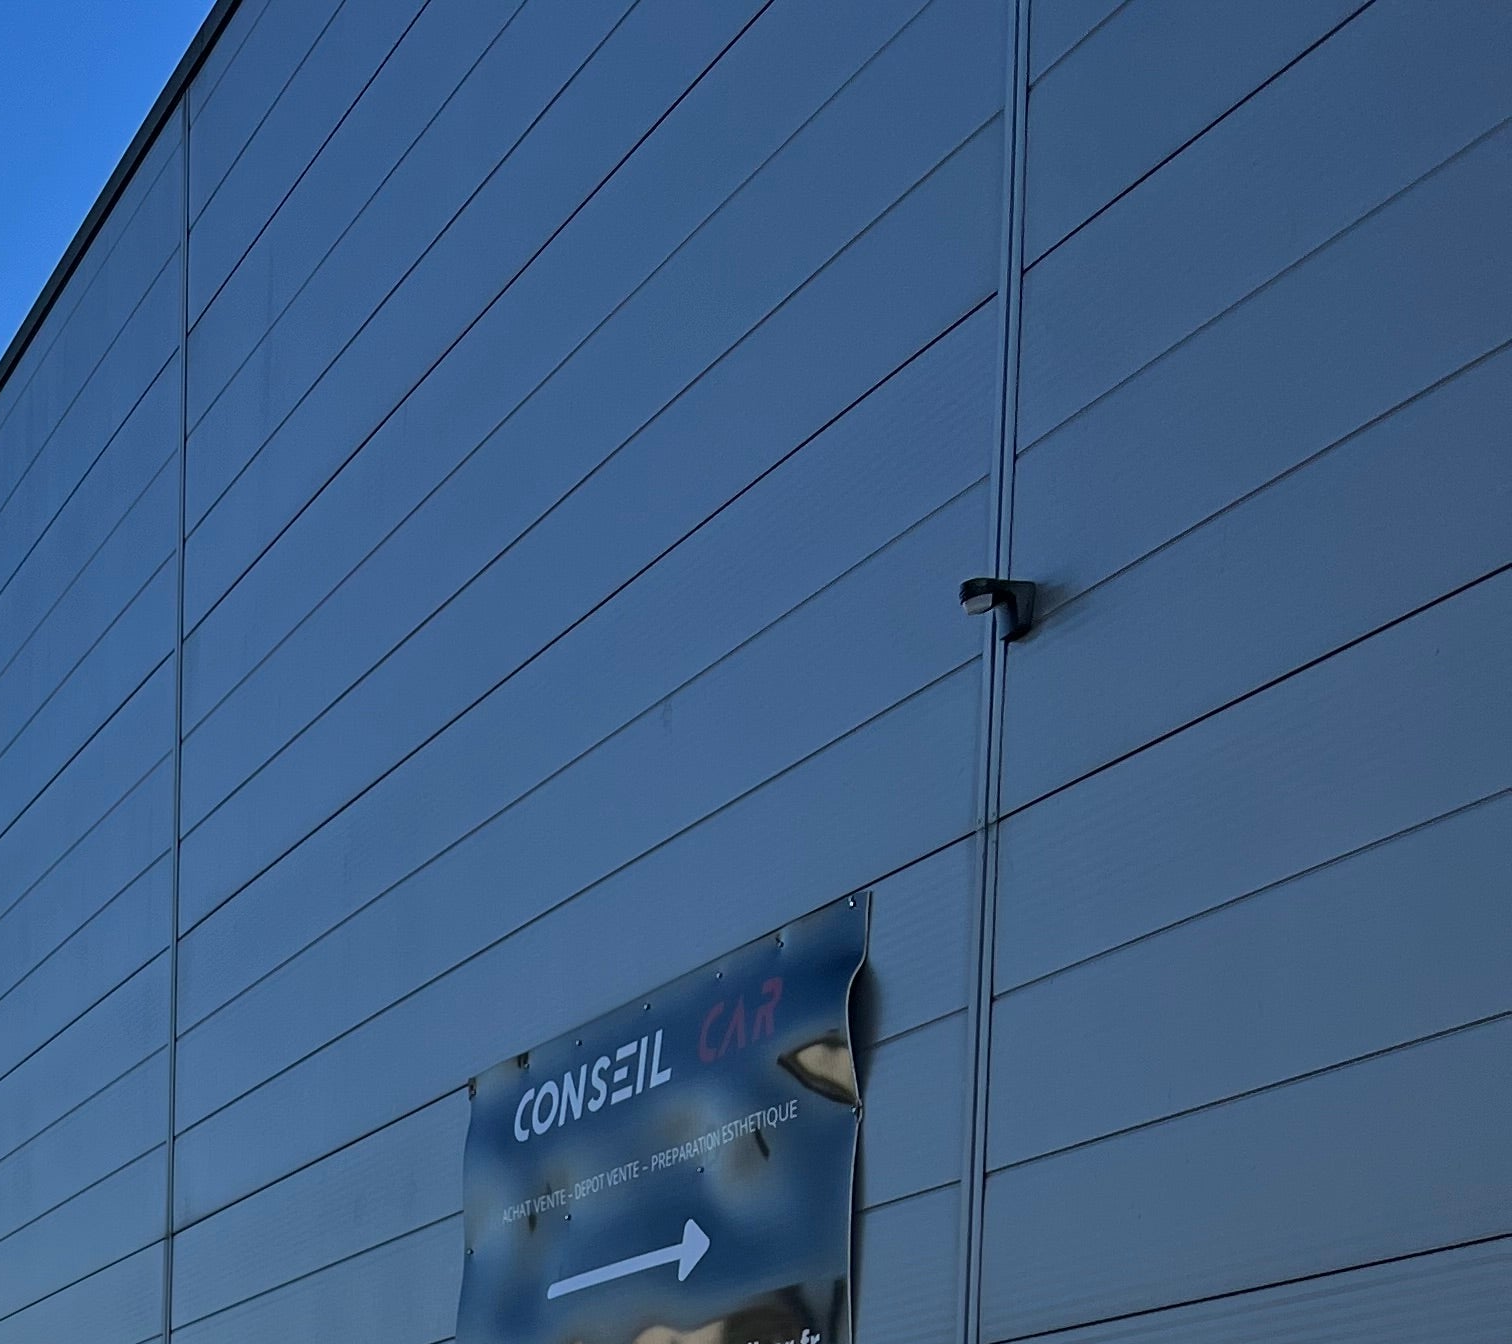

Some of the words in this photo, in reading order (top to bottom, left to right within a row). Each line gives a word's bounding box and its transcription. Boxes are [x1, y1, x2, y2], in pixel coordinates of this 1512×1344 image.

[514, 1028, 672, 1142] CONSEIL
[697, 976, 784, 1063] CAR
[502, 1200, 531, 1224] ACHAT
[533, 1188, 567, 1213] VENTE
[574, 1173, 604, 1200] DEPOT
[606, 1160, 639, 1187] VENTE
[651, 1130, 720, 1172] PREPARATION
[722, 1099, 799, 1144] ESTHETIQUE
